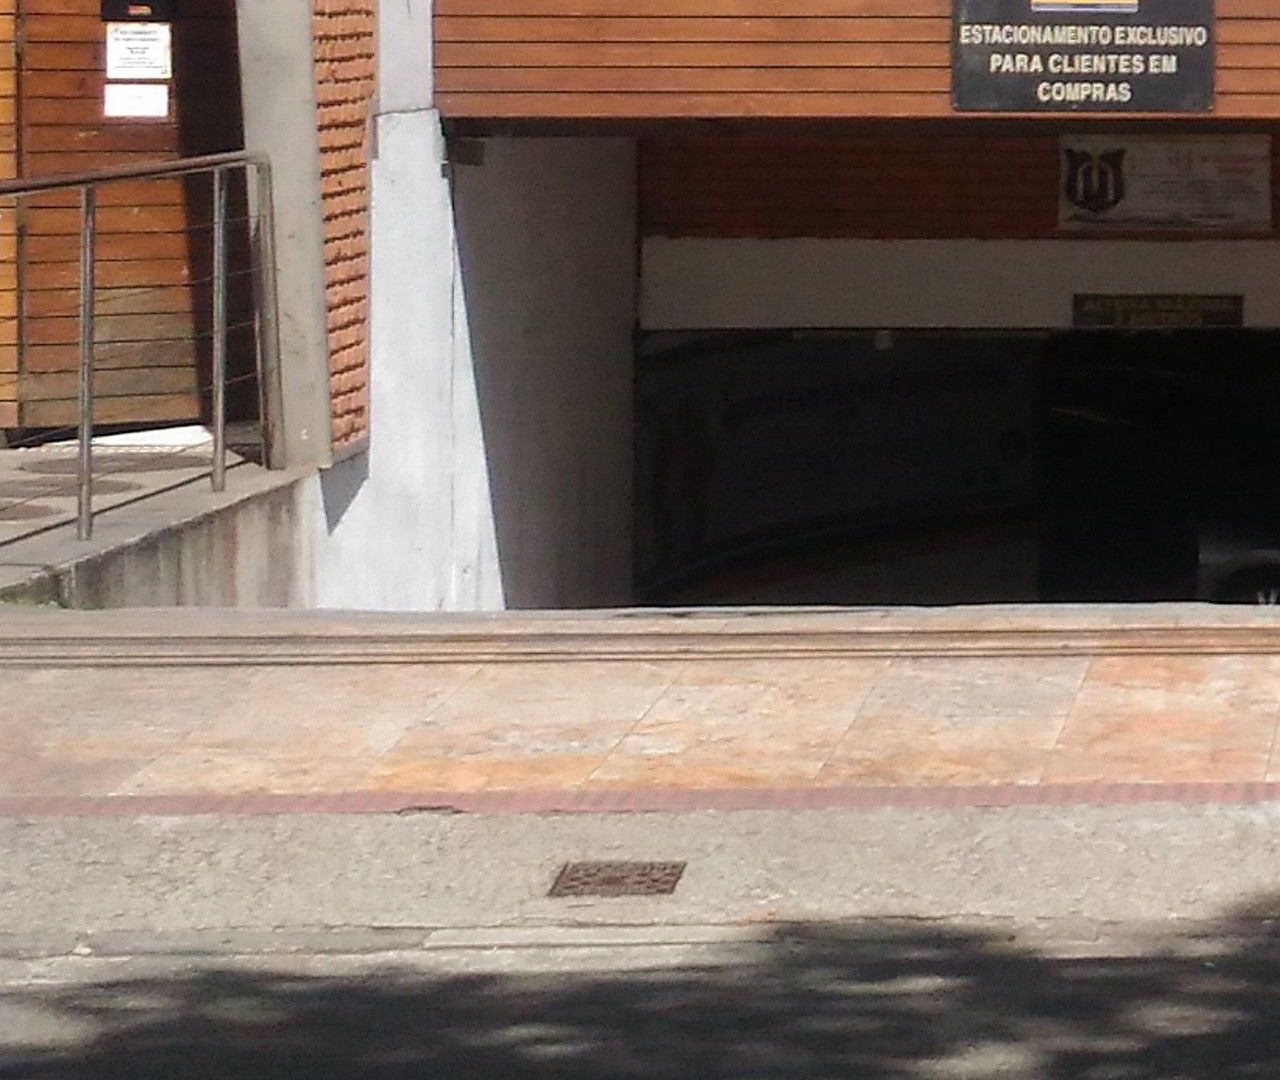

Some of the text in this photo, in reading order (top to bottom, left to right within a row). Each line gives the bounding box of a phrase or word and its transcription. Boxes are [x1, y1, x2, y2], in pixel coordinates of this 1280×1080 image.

[959, 25, 1207, 46] ESTACIONAMENTO EXCLUSIVO
[989, 54, 1178, 74] PARA CLIENTES EM
[1036, 82, 1132, 102] COMPRAS
